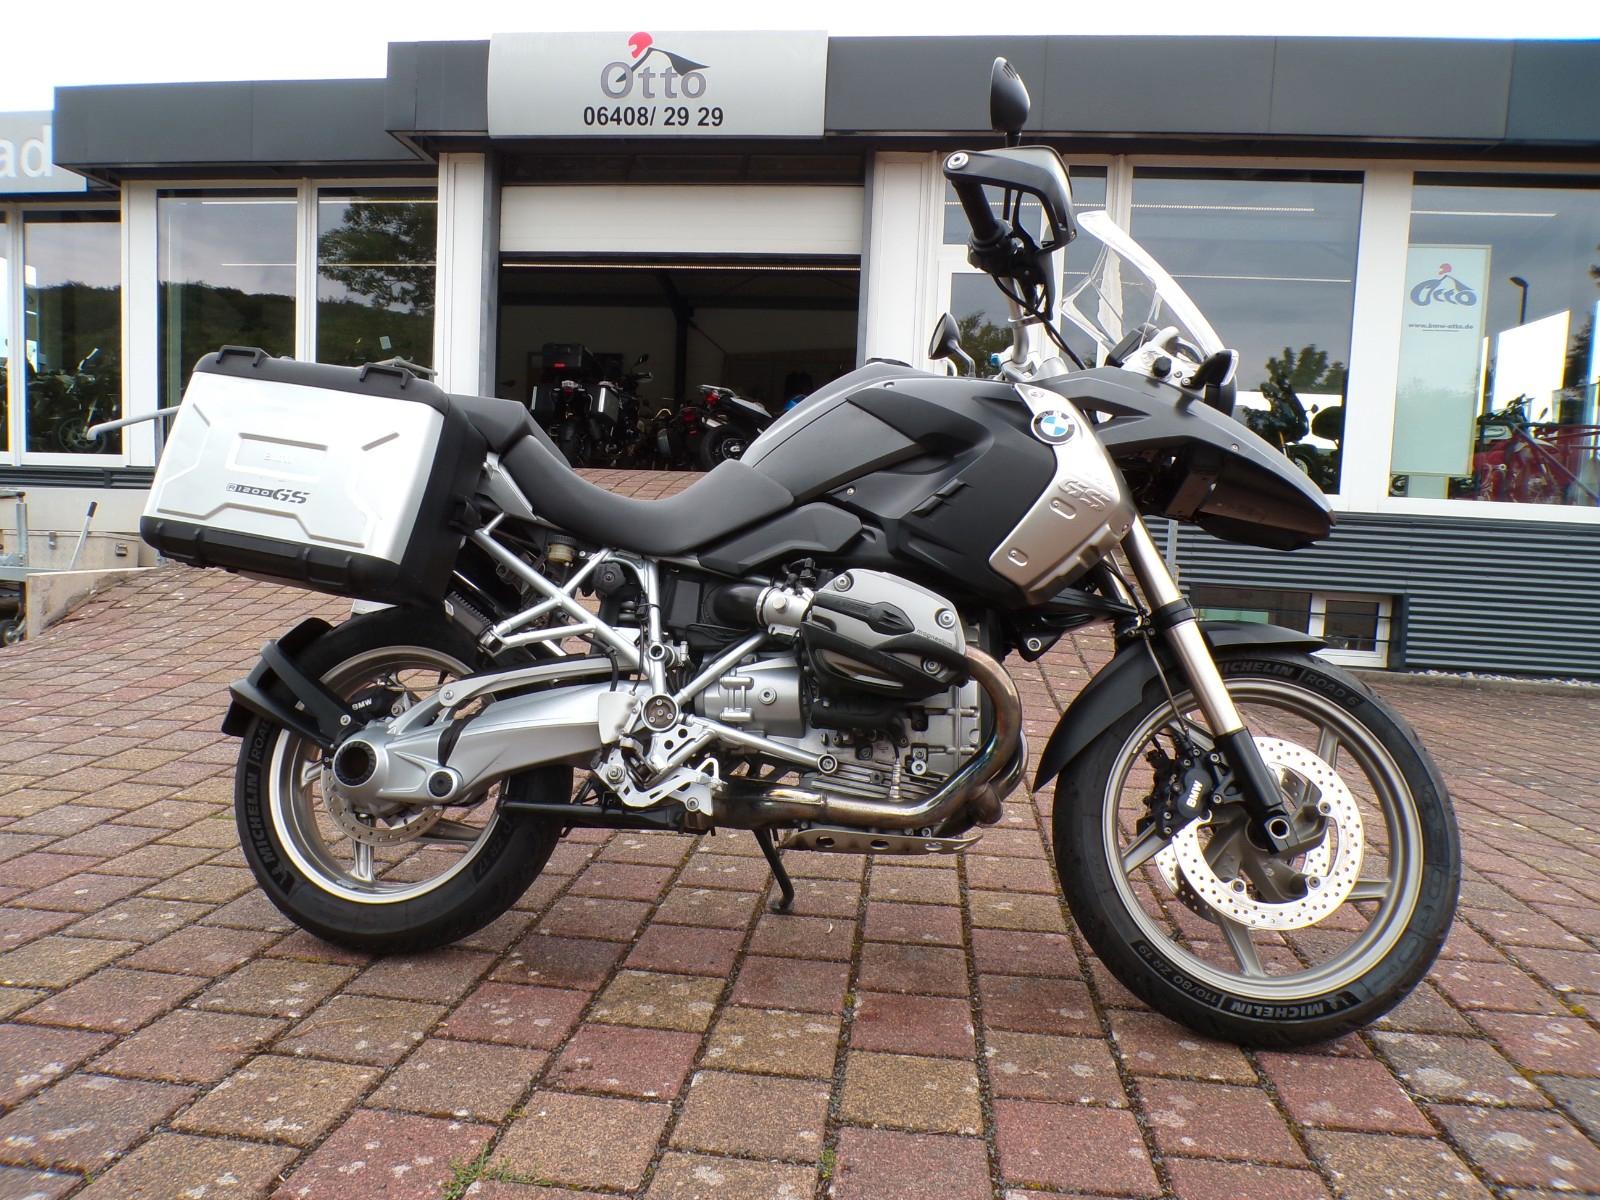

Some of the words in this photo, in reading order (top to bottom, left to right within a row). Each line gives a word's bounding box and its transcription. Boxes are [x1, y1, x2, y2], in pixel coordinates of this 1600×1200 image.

[600, 61, 707, 99] Otto
[583, 106, 657, 127] 06408/
[663, 106, 690, 127] 29
[697, 106, 724, 127] 29
[1304, 673, 1347, 698] ROAD
[351, 697, 373, 711] BMW
[1186, 779, 1203, 808] BMW
[246, 772, 276, 863] MICHELIN
[1138, 944, 1153, 959] 19
[1153, 959, 1172, 975] ZR
[1172, 974, 1218, 1005] 110/80
[1230, 1001, 1325, 1018] MICHELIN
